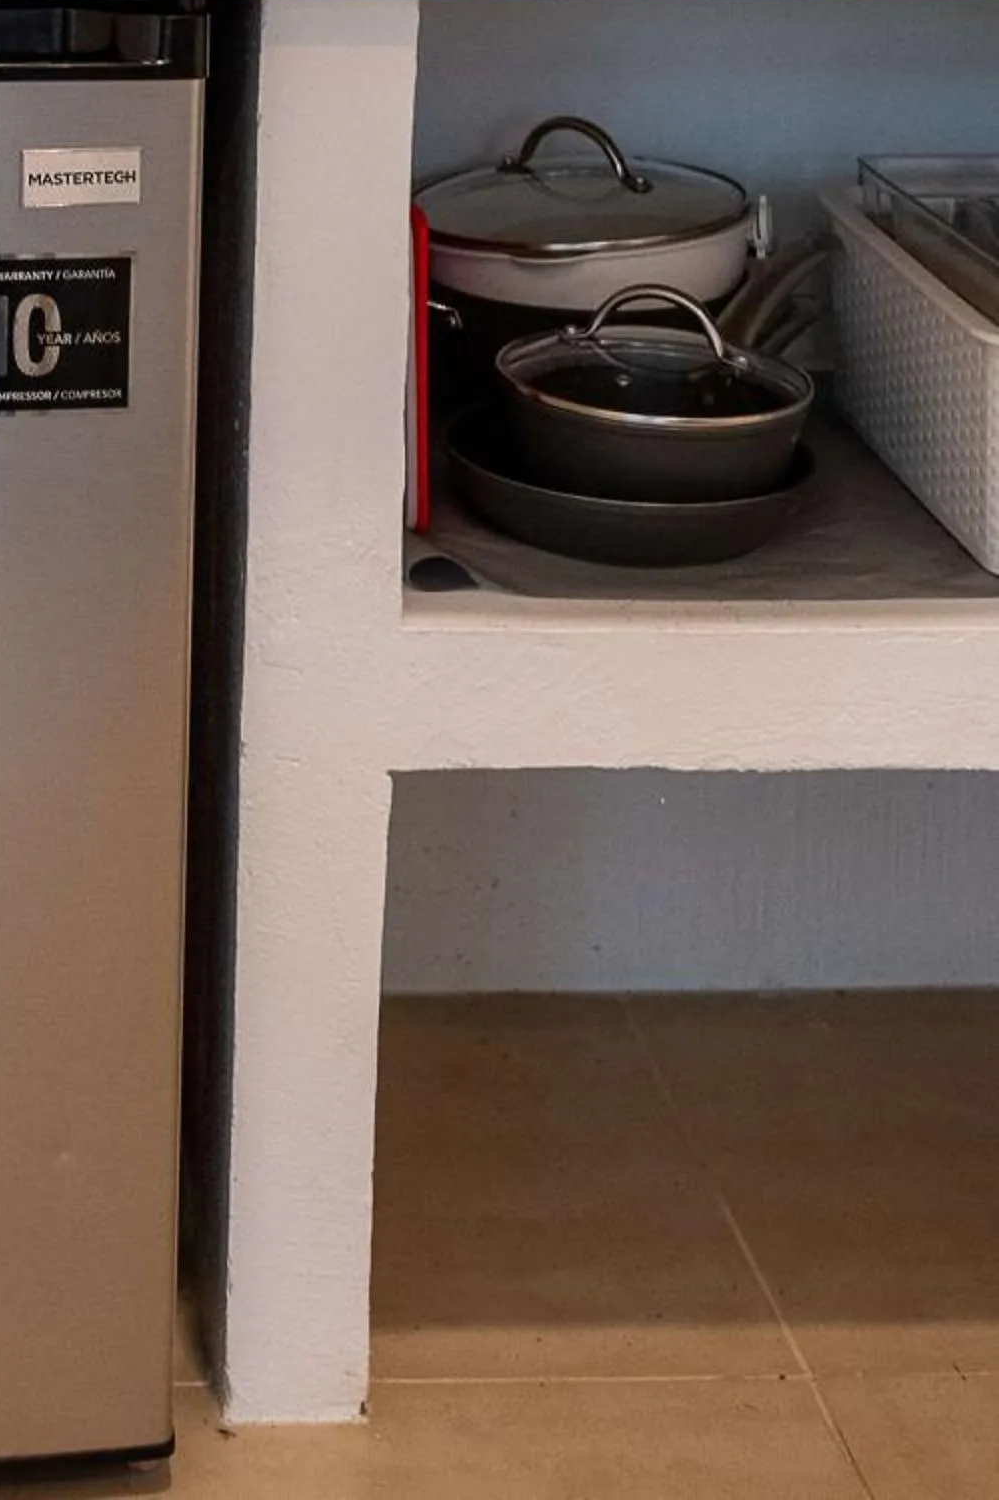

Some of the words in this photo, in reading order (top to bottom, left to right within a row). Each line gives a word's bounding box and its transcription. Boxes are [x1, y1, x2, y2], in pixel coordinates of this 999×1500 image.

[37, 332, 72, 345] YEAR
[83, 329, 121, 344] AÑOS
[60, 387, 122, 401] COMPRESOR
